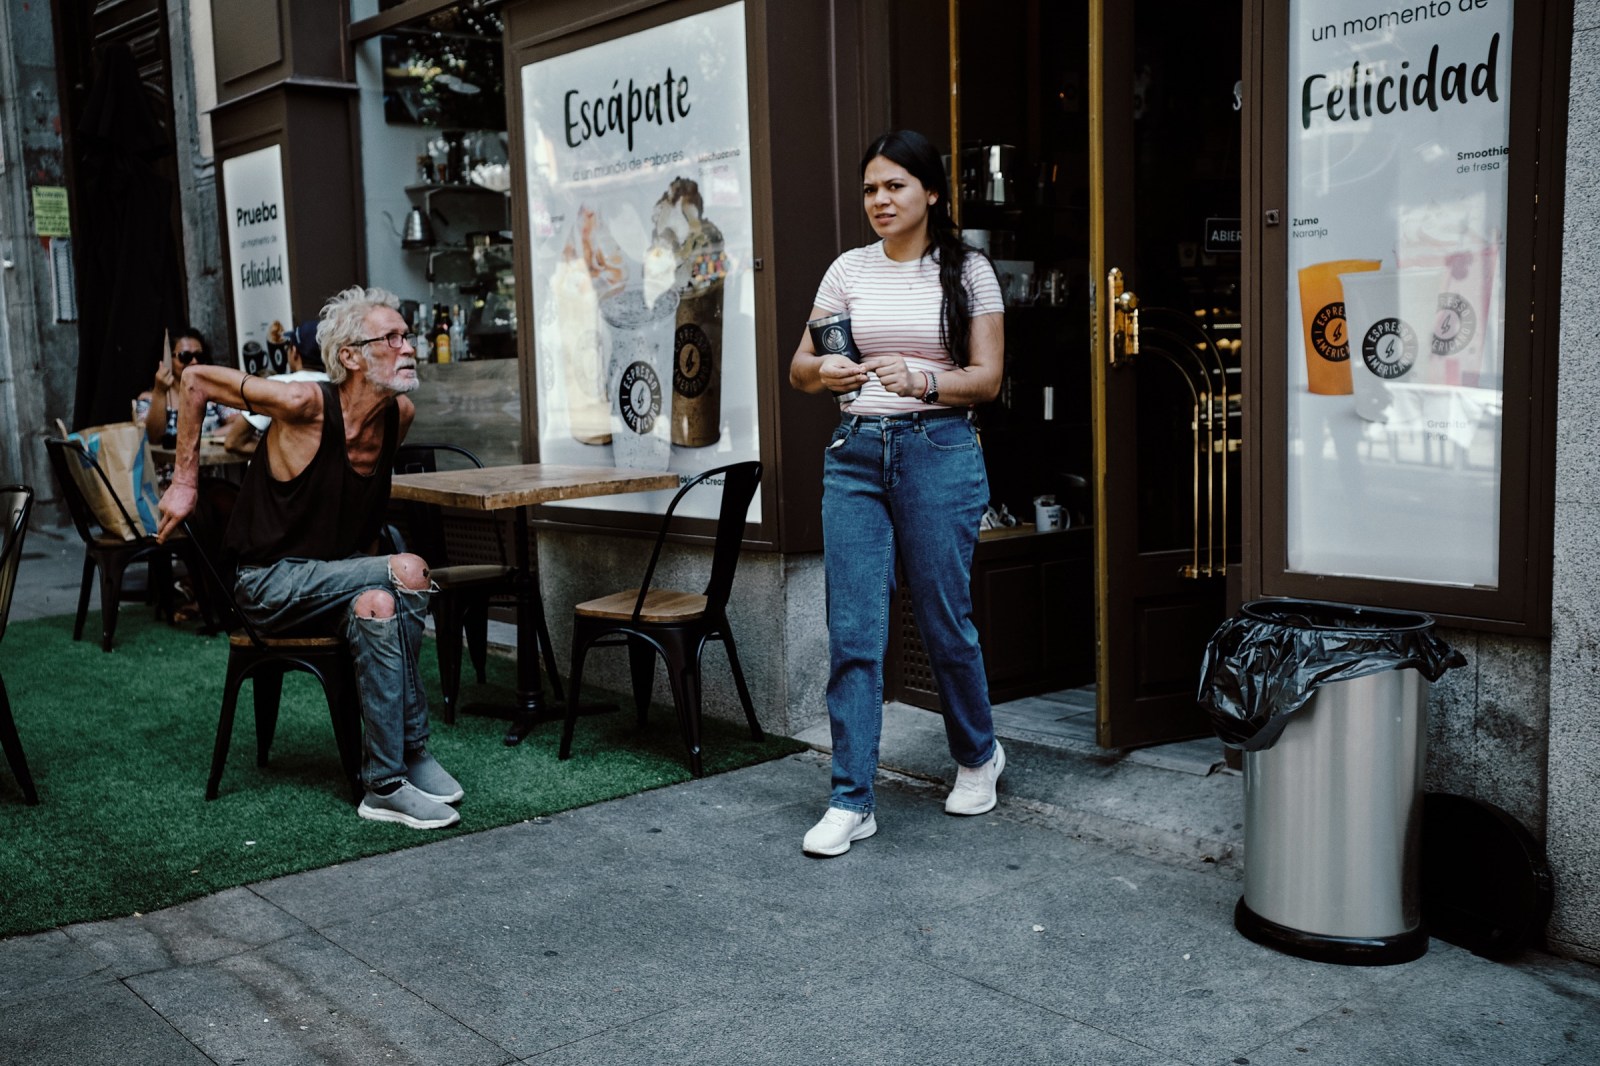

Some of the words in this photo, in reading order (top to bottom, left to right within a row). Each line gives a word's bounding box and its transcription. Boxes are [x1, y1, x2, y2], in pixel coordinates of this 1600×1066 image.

[1311, 23, 1337, 42] un
[1343, 0, 1452, 36] momento
[1301, 32, 1500, 130] Felicidad
[563, 67, 692, 151] Escápate
[1457, 145, 1510, 161] Smoothie
[594, 160, 627, 178] mundo
[629, 157, 642, 170] de
[1456, 163, 1471, 174] de
[1472, 161, 1500, 172] fresa
[236, 201, 278, 227] Prueba
[1292, 217, 1319, 227] Zumo
[1211, 229, 1242, 242] ABIER
[1292, 228, 1328, 240] Naranja
[240, 254, 283, 290] Felicidad
[1316, 306, 1344, 327] ESPRE
[1440, 296, 1471, 317] RESSO
[1367, 321, 1413, 342] ESPRESSO
[1432, 327, 1471, 352] ERICANO
[1315, 338, 1351, 359] AMERIC
[1367, 352, 1412, 376] AMERICANO
[623, 365, 658, 390] ESPRESSO
